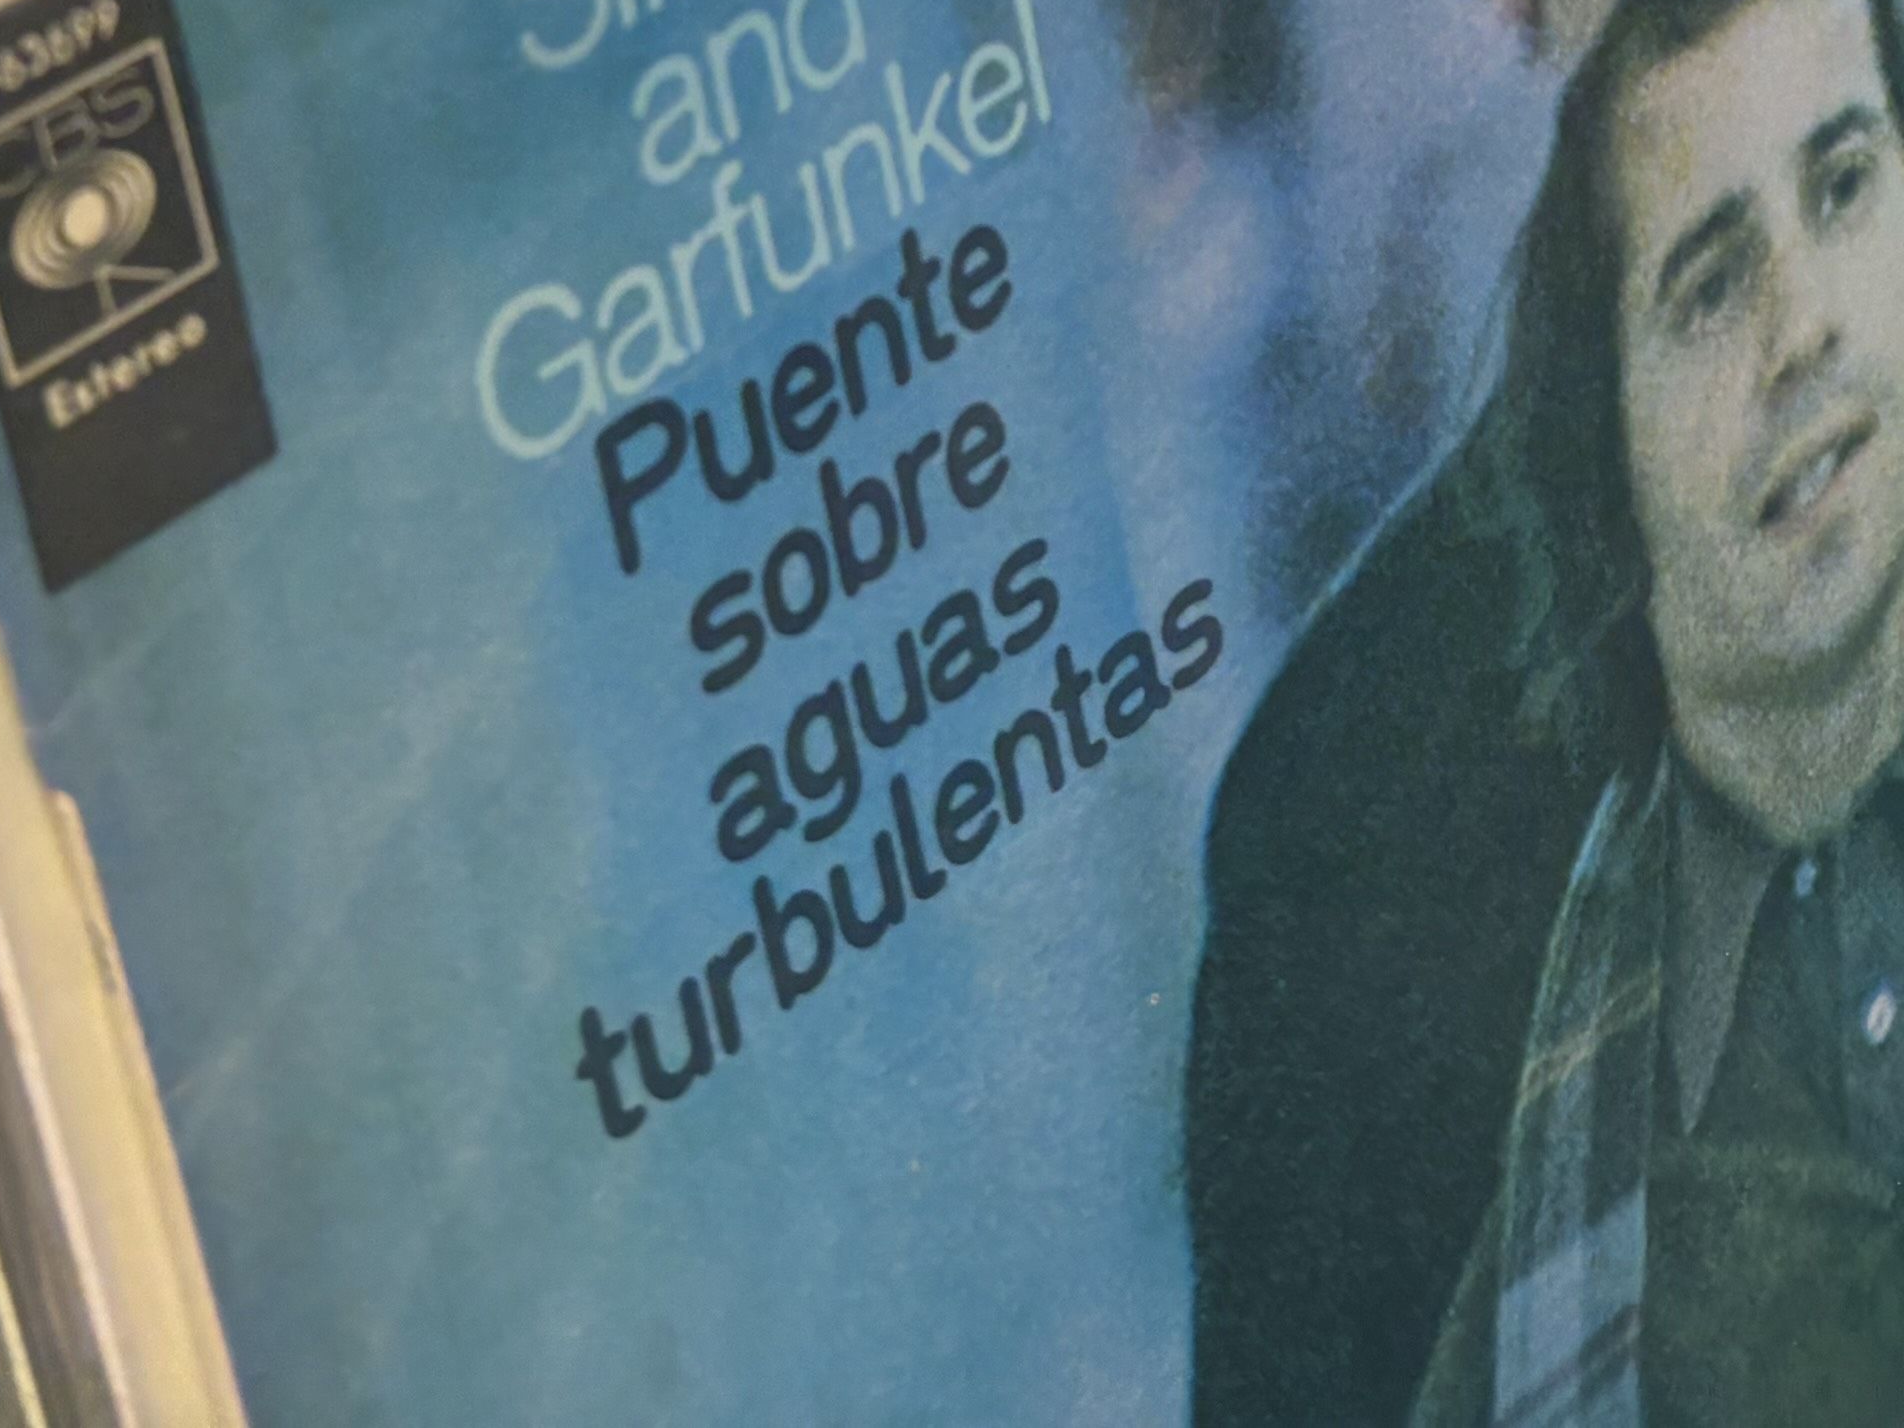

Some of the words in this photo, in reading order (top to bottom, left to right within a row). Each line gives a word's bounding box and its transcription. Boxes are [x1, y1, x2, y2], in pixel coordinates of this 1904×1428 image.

[590, 221, 1015, 576] Puente
[686, 399, 1011, 696] sobre
[575, 575, 1227, 1141] turbulentas
[706, 535, 1062, 865] aguas
